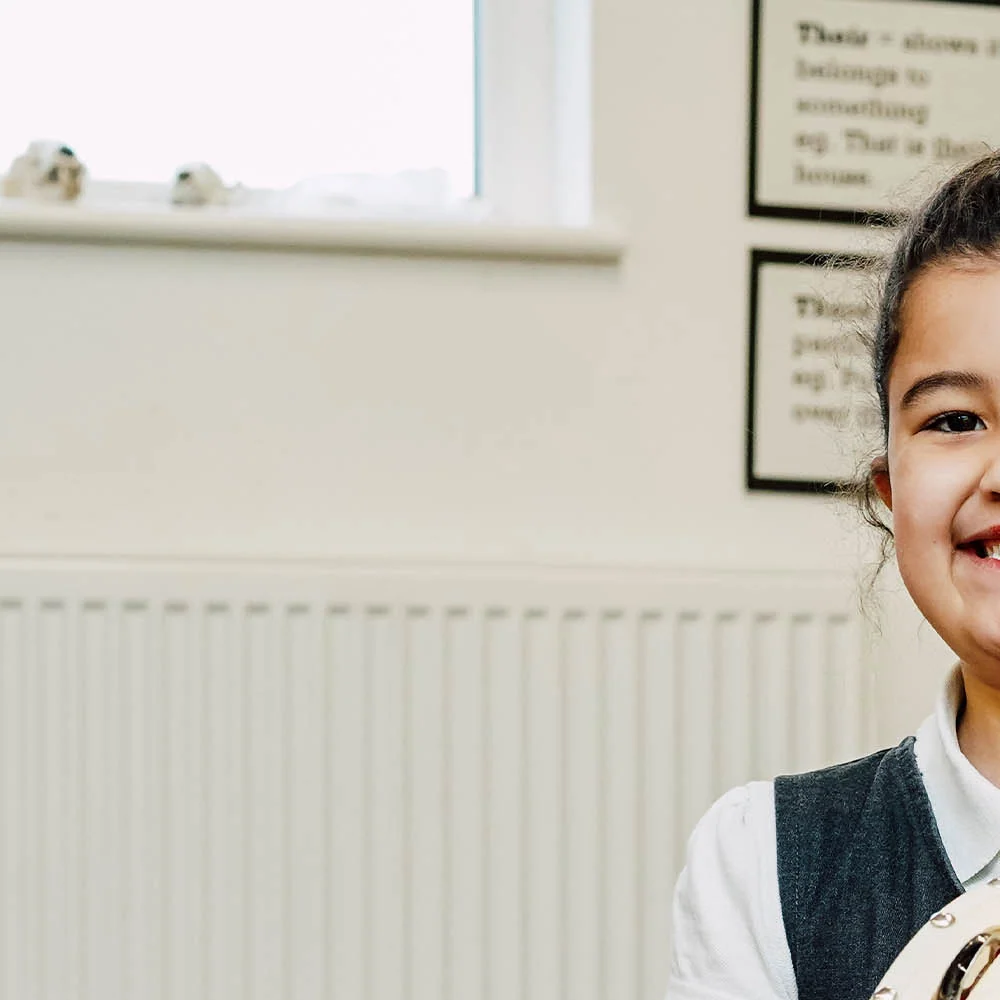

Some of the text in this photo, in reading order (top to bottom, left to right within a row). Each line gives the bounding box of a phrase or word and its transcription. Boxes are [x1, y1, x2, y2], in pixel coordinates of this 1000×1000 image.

[904, 30, 979, 54] shows
[796, 59, 930, 88] belongs to
[796, 98, 929, 125] something
[844, 128, 898, 154] That
